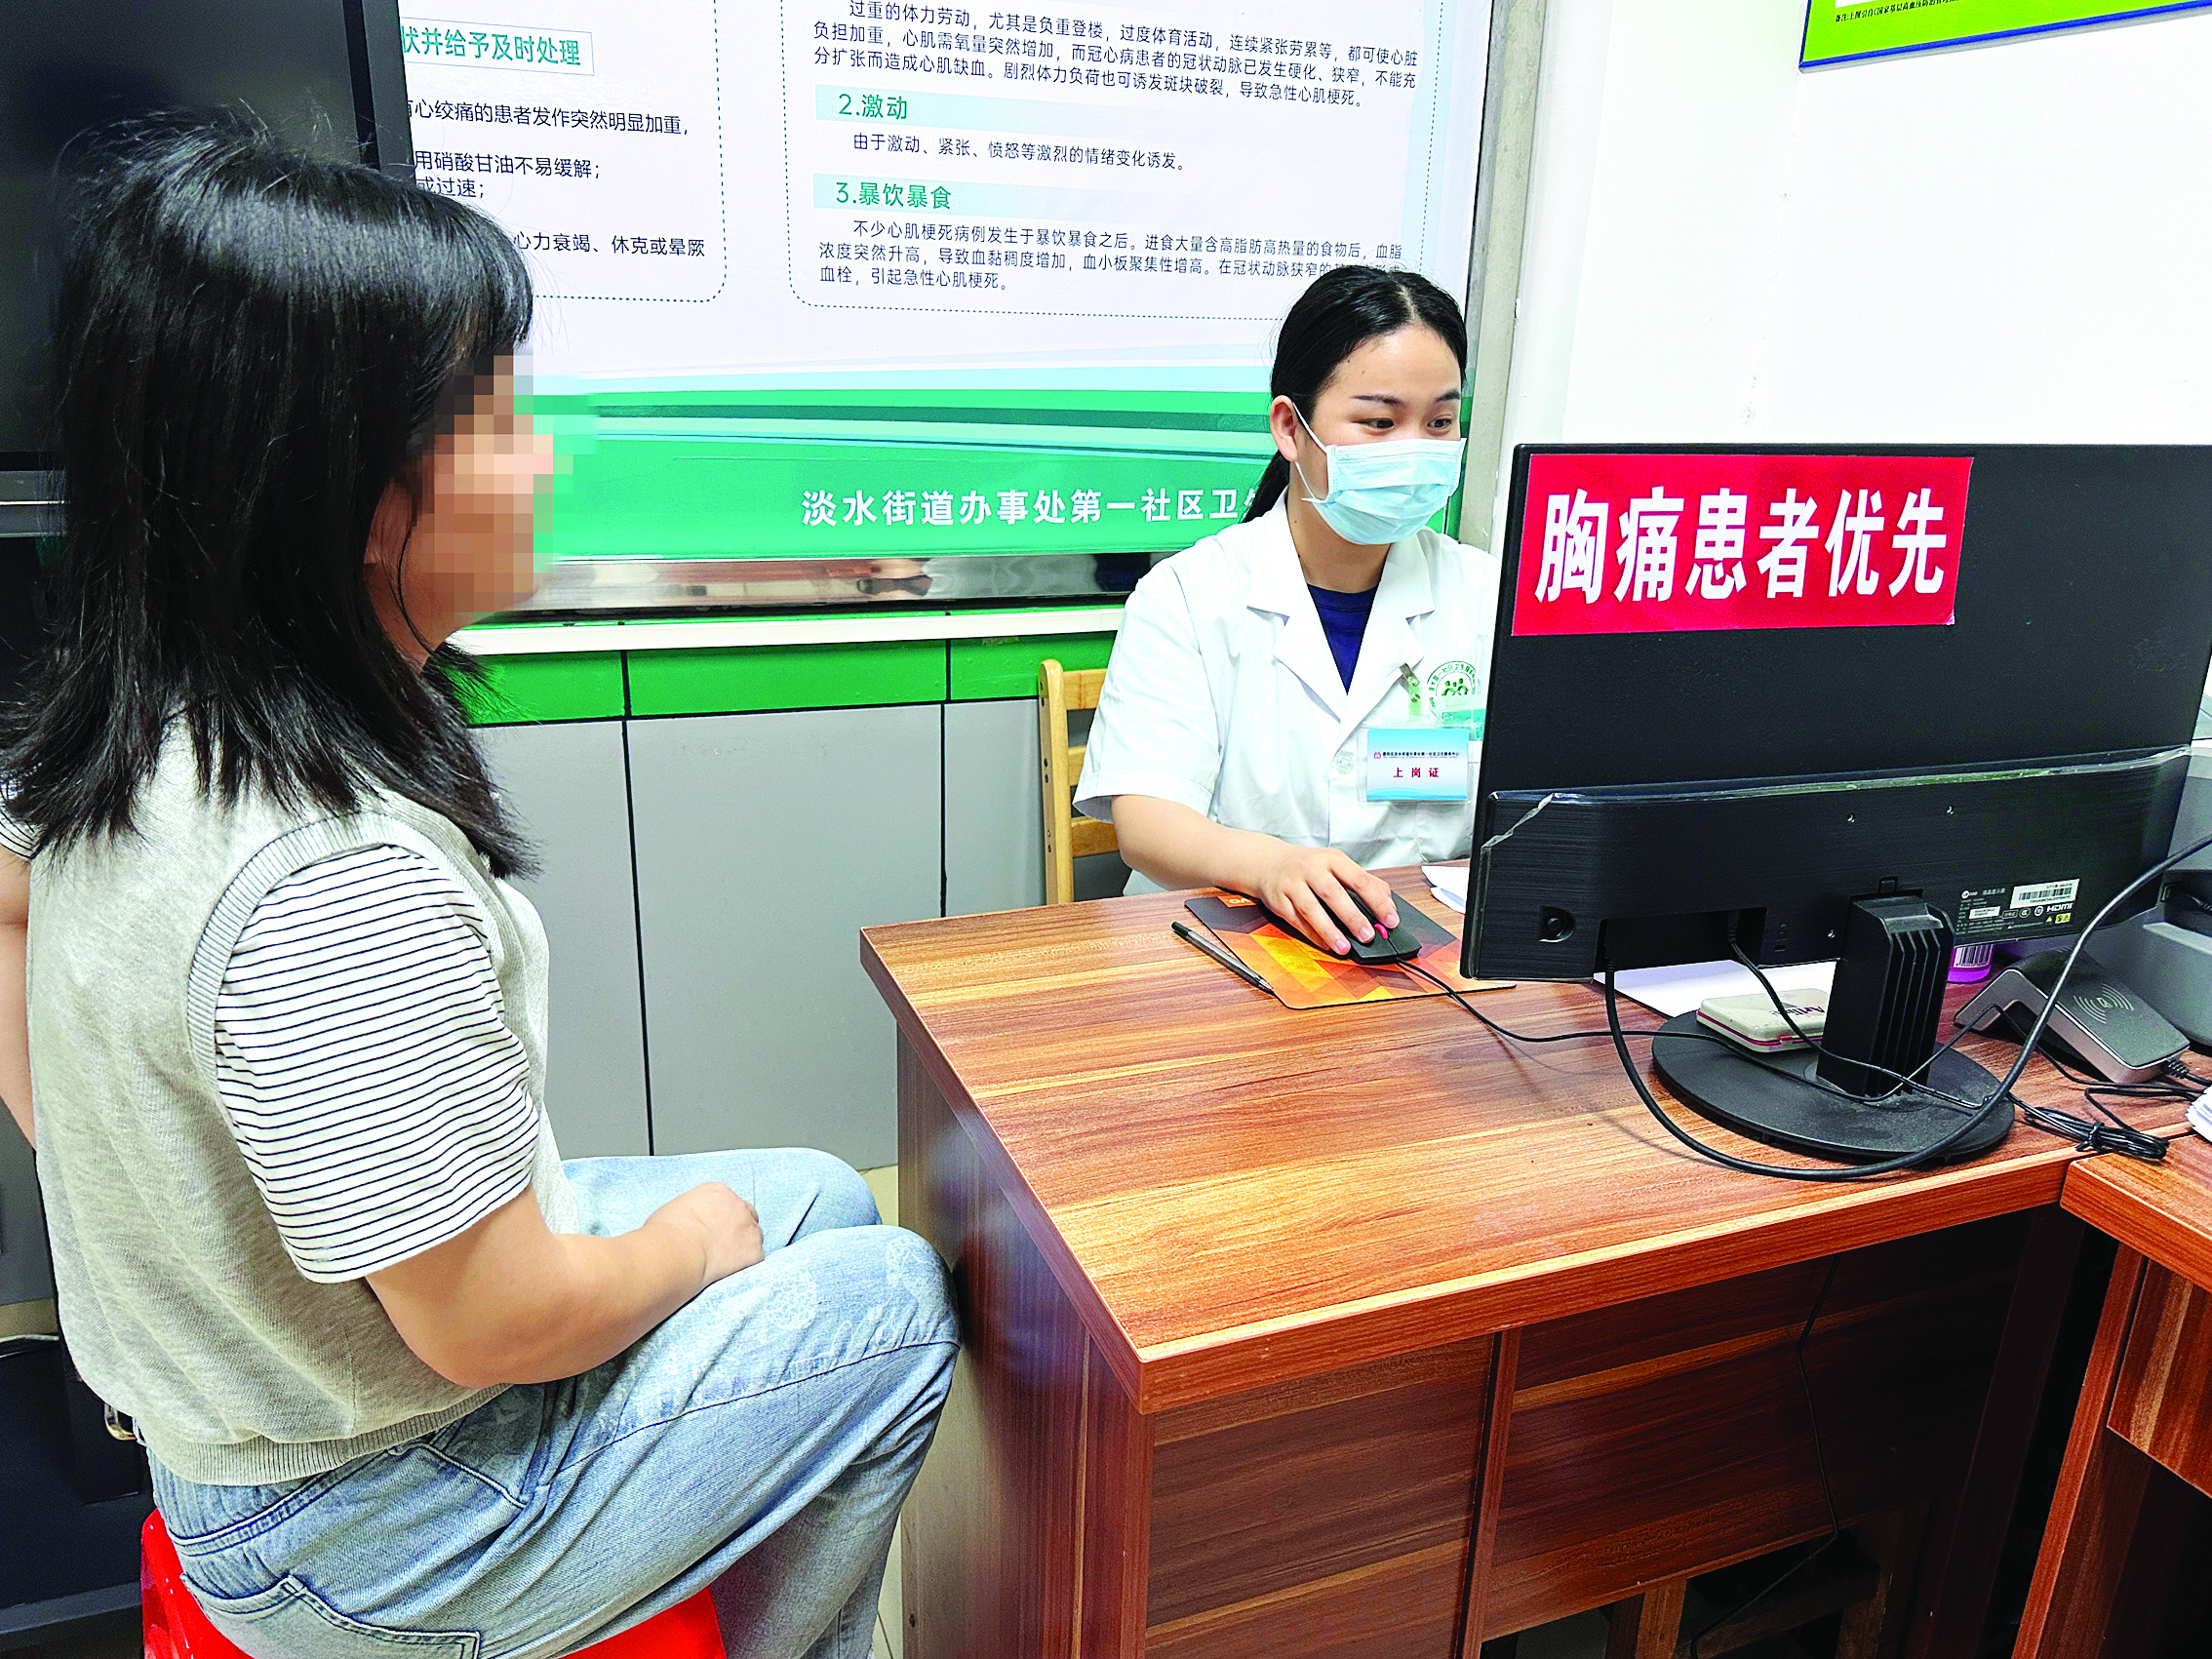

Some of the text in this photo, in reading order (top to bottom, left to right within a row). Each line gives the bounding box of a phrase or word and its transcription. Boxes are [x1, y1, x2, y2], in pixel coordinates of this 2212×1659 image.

[401, 25, 581, 65] 状并给予及时处理
[838, 93, 908, 120] 2.激动
[853, 134, 1184, 172] 由于激动、紧张、愤怒等激烈的情绪变化诱发。
[836, 181, 952, 210] 3.暴饮暴食
[514, 232, 705, 257] 心力衰竭、休克或晕厥
[819, 242, 1402, 278] 浓度突然升高，导致血黏稠度增加，血小板聚集性增高。在冠状动脉狭窄的
[820, 266, 1007, 291] 血栓，引起急性心肌梗死。
[1534, 485, 1947, 604] 胸痛患者优先
[1393, 767, 1440, 778] 上岗证
[2046, 902, 2074, 913] HDMI
